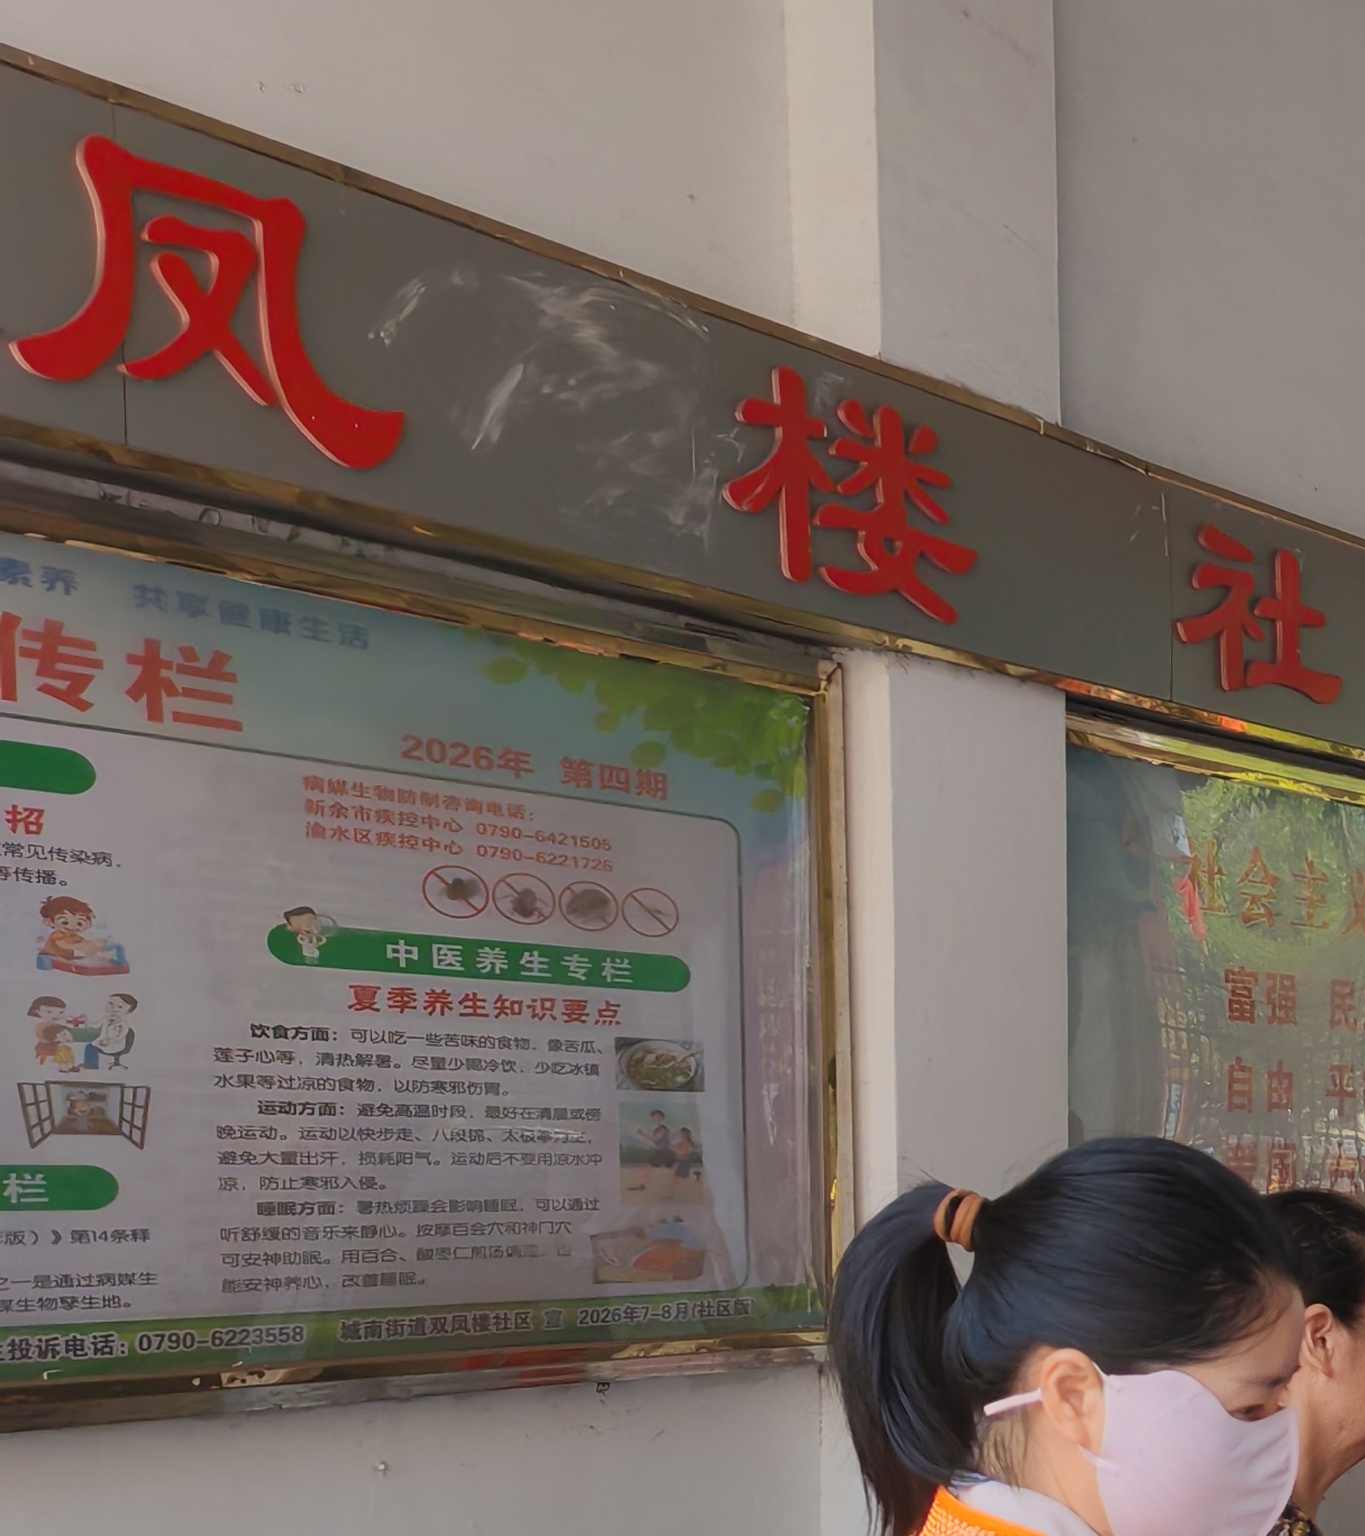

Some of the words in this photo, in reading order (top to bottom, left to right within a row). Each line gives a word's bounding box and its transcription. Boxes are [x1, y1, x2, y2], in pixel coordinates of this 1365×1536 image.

[400, 733, 535, 779] 2026年
[559, 756, 670, 802] 第四期
[4, 804, 46, 835] 招
[305, 798, 464, 833] 新余市疾控中心
[305, 821, 464, 856] 渝水区疾控中心
[386, 939, 635, 985] 中医养生专栏
[347, 983, 622, 1027] 夏季养生知识要点
[1225, 966, 1297, 1026] 富强
[1226, 1056, 1294, 1113] 自由
[3, 1172, 49, 1204] 栏
